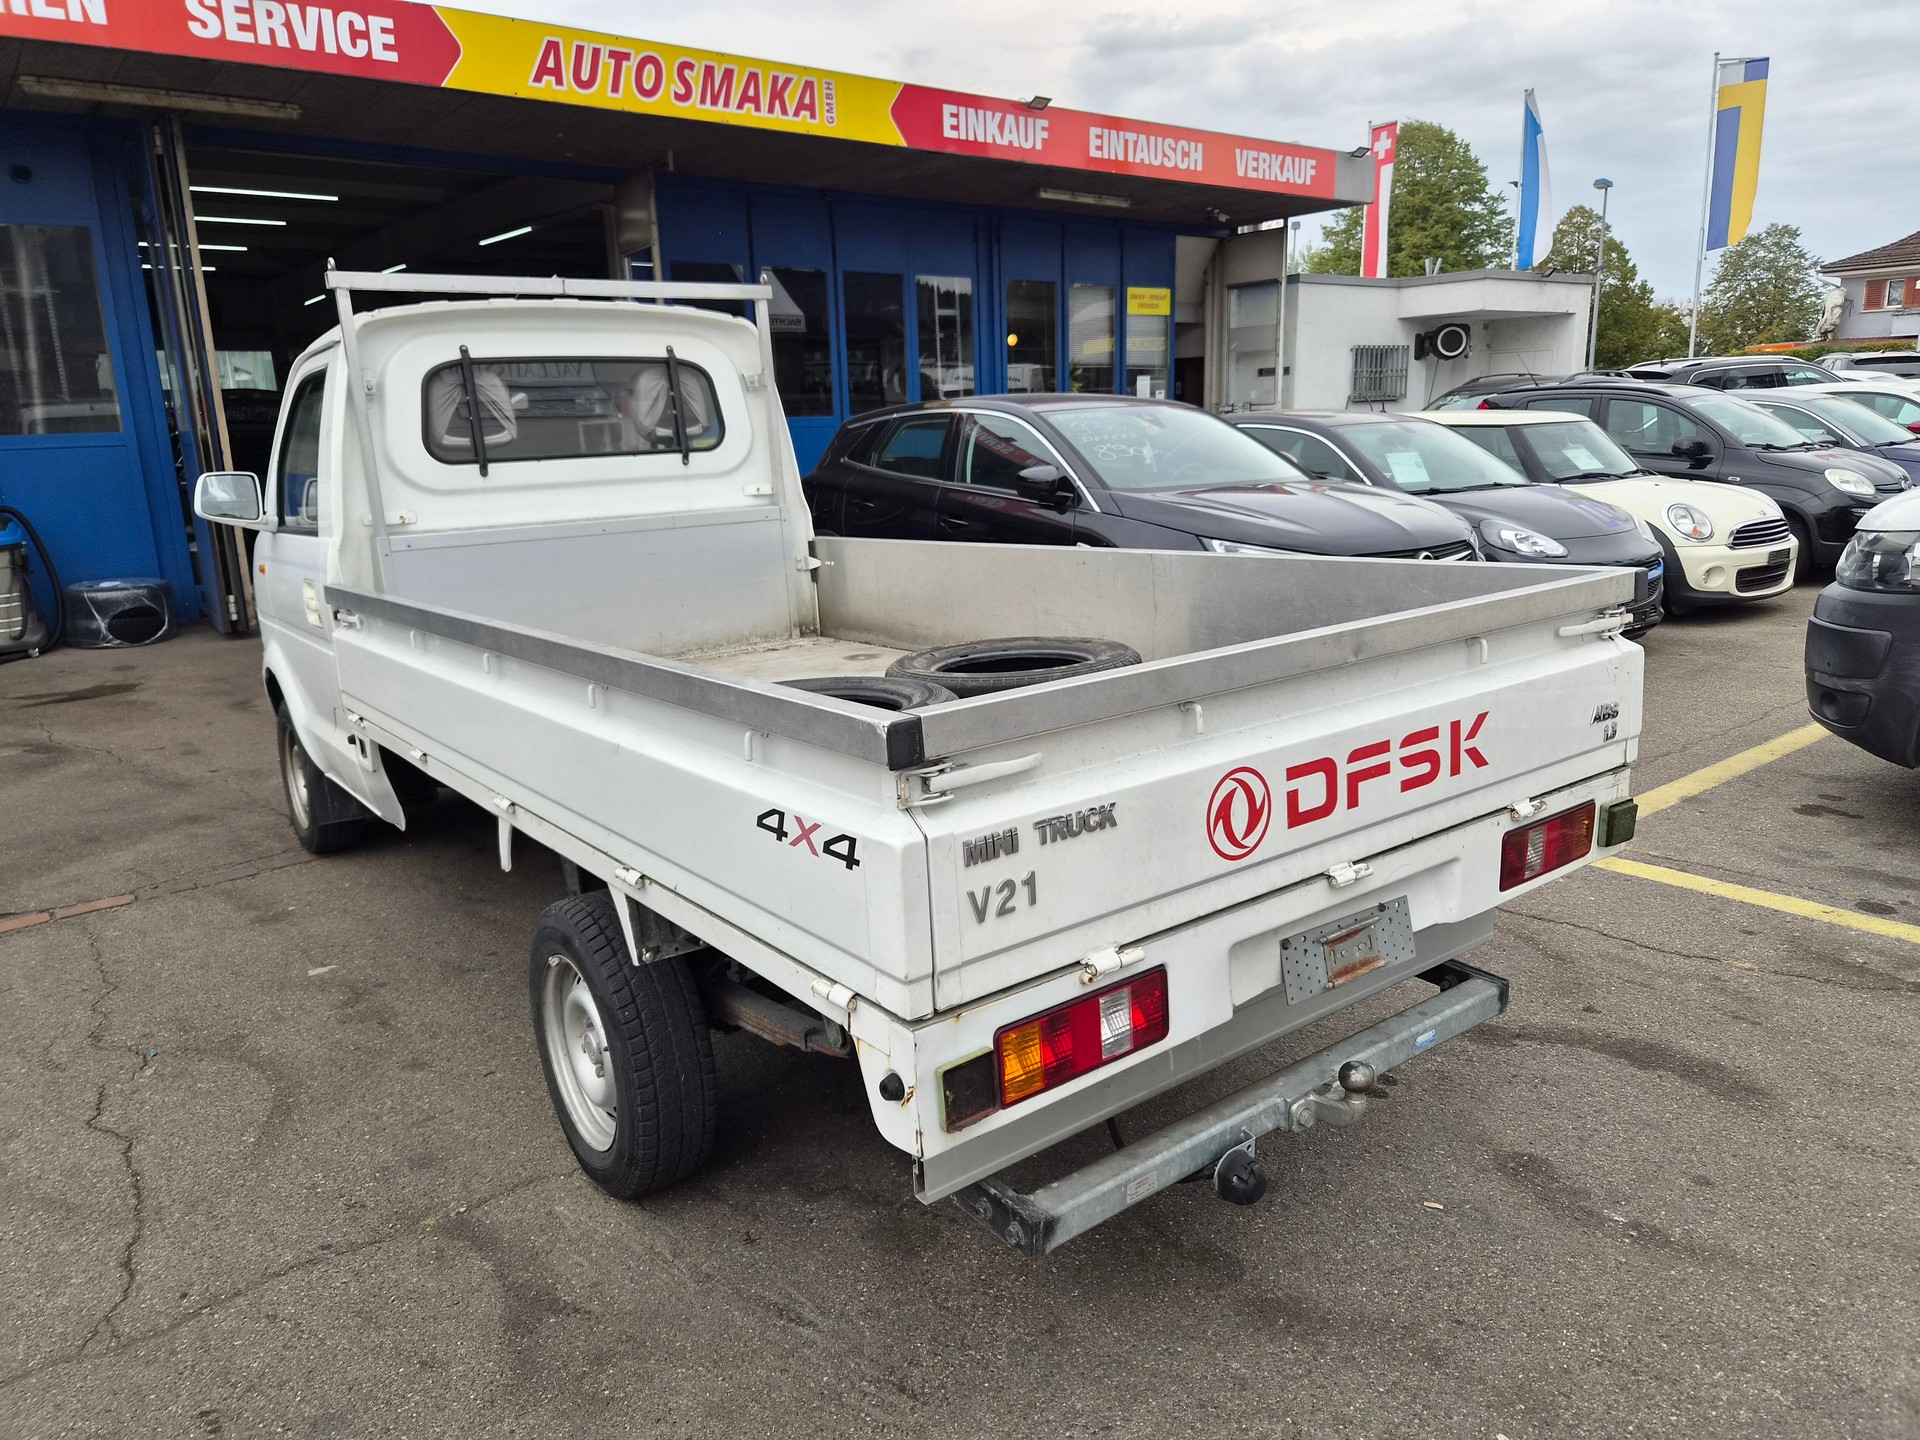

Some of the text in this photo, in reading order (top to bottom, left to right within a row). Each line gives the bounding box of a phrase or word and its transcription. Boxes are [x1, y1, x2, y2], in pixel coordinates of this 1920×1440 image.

[185, 0, 399, 63] SERVICE
[531, 37, 835, 125] AUTO SMAKA GMBH
[942, 104, 1316, 185] EINKAUF EINTAUSCH VERKAUF
[1590, 701, 1620, 726] ABS
[1286, 711, 1490, 829] DFSK
[962, 802, 1119, 868] MINI TRUCK
[966, 870, 1038, 924] V21
